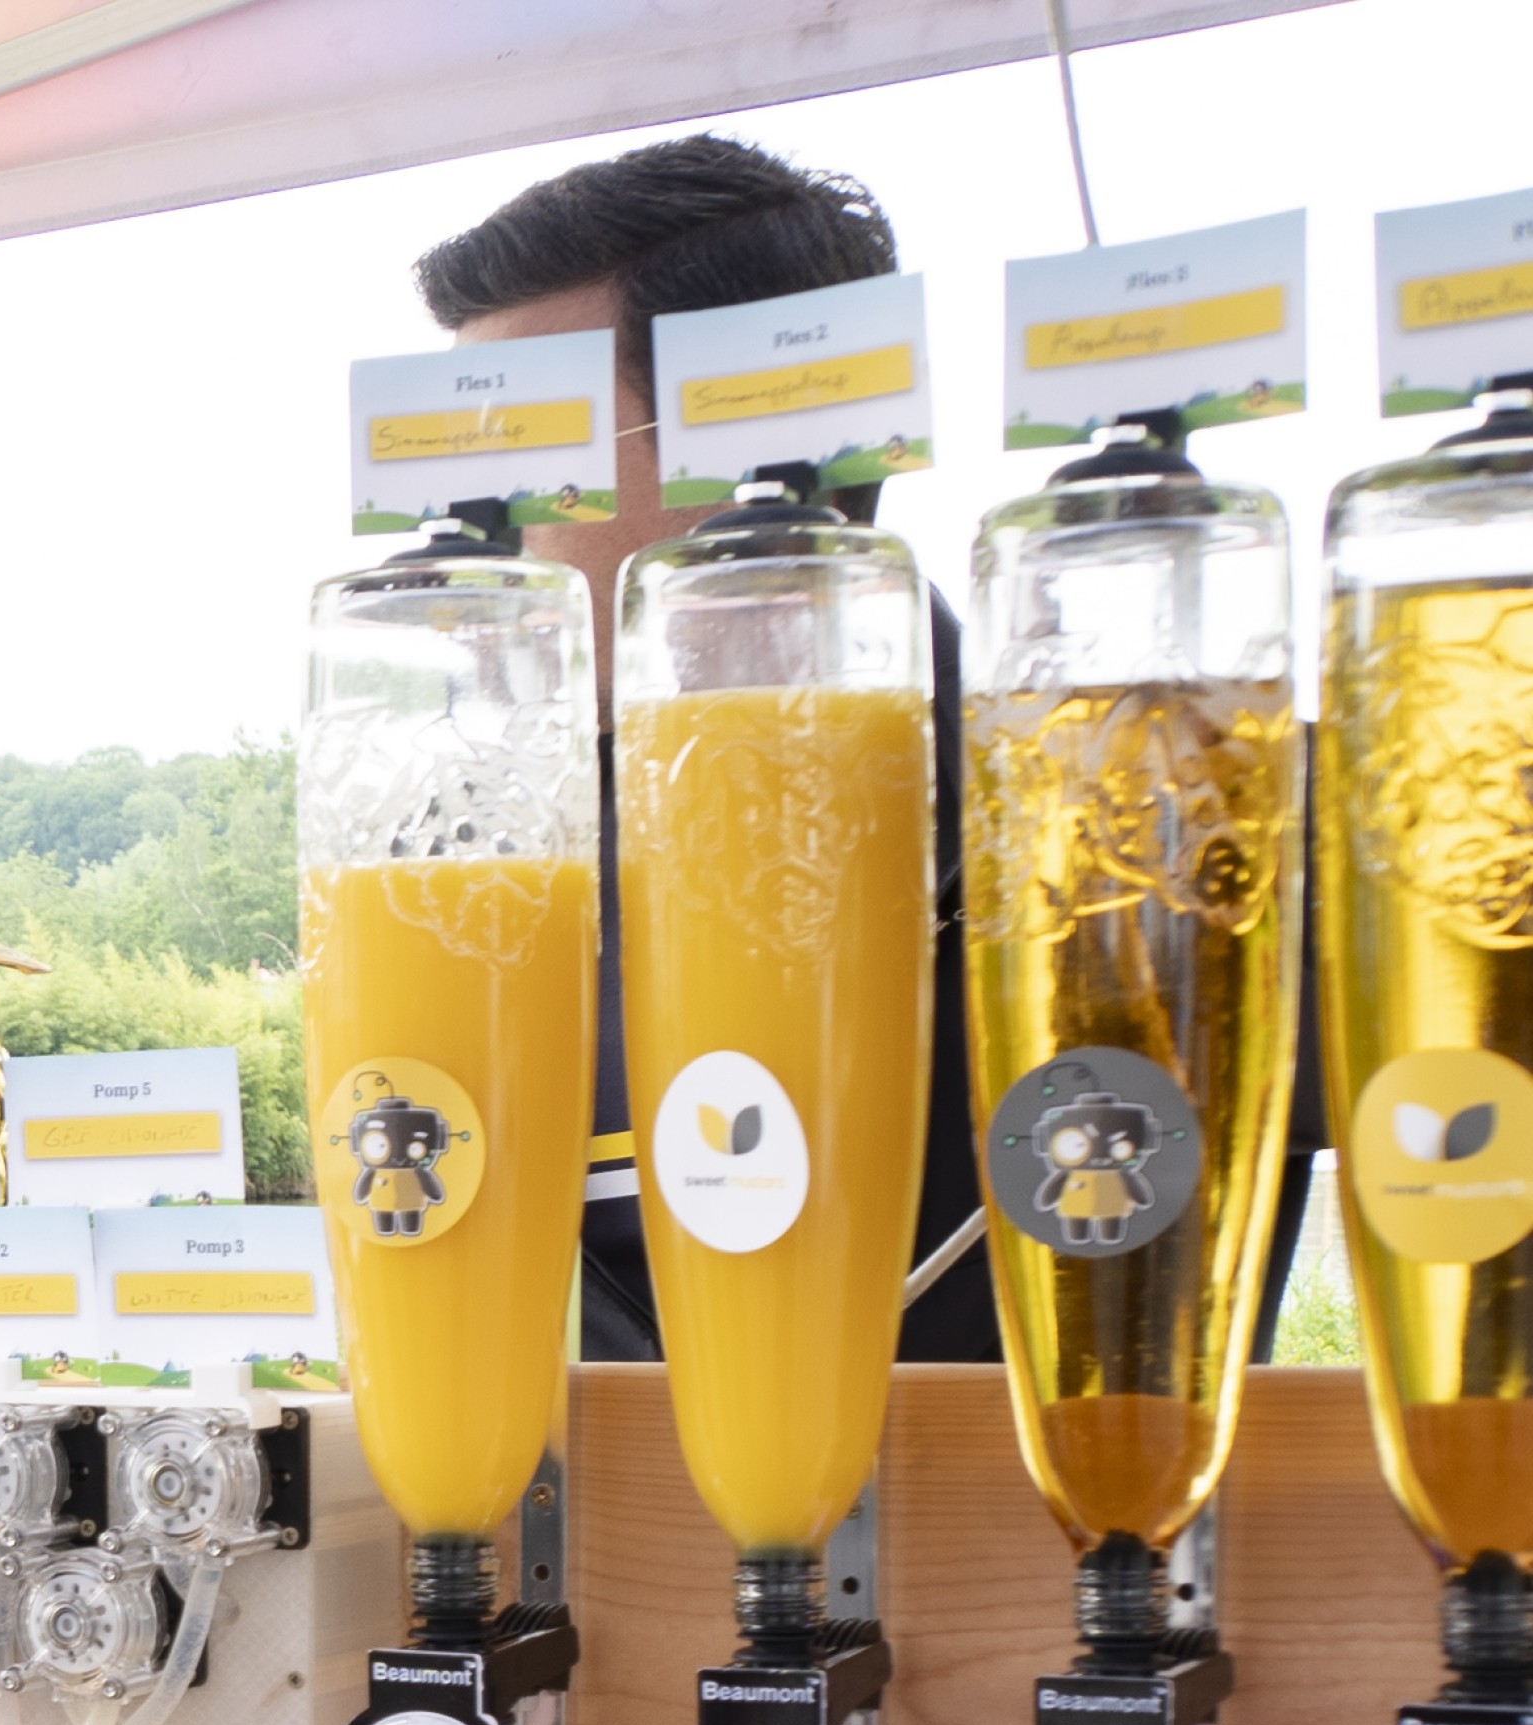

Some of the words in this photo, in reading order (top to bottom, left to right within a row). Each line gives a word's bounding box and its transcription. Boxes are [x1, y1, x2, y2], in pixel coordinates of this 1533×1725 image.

[773, 328, 812, 349] Fles
[816, 322, 829, 342] 2
[455, 373, 492, 393] Fles
[497, 371, 506, 389] 1
[94, 1083, 139, 1100] Pomp
[142, 1082, 152, 1096] 5
[0, 1243, 9, 1257] 2
[186, 1239, 233, 1257] Pomp
[235, 1239, 245, 1254] 3
[372, 1661, 474, 1686] Beaumont
[701, 1680, 816, 1704] Beaumont
[1039, 1689, 1164, 1714] Beaumont
